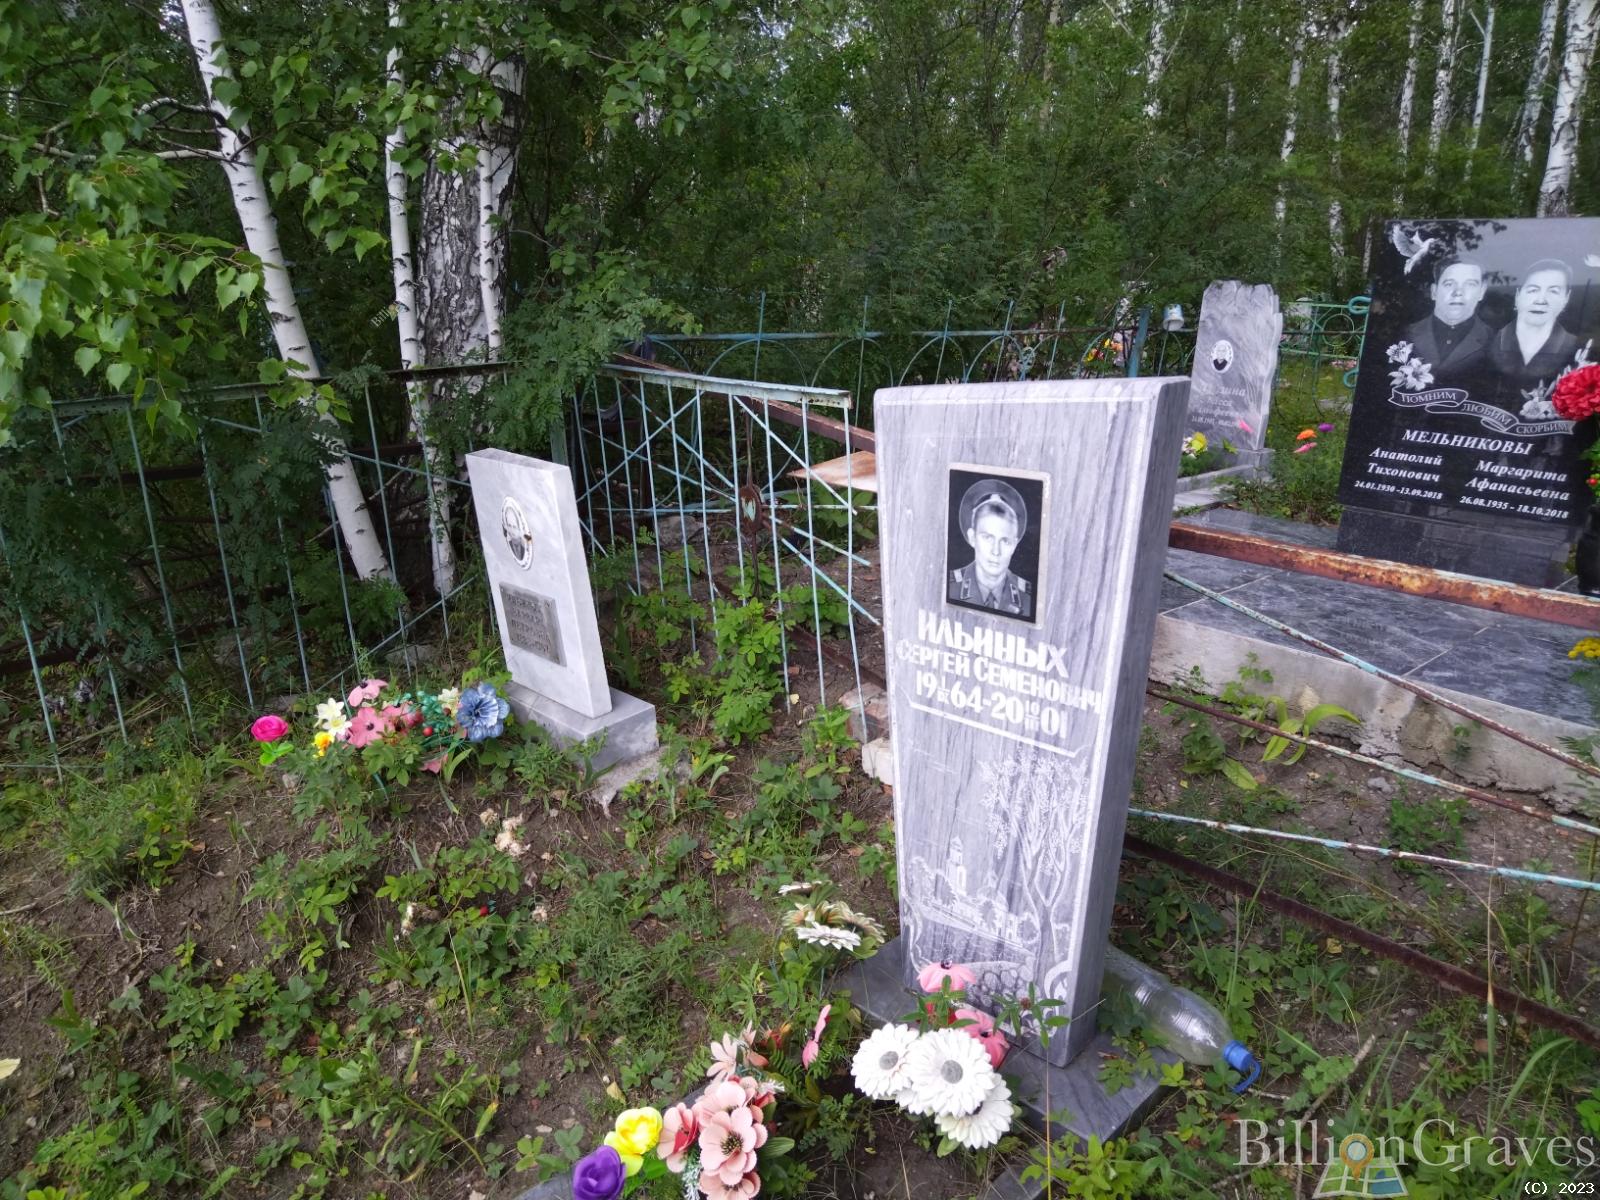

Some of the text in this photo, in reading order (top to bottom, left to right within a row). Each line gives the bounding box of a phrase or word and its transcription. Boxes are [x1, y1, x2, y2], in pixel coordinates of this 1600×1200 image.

[1401, 391, 1457, 404] ПОМНИМ
[1461, 403, 1513, 425] ЛЮБИМ
[1516, 422, 1568, 434] СКОРБИМ
[1402, 429, 1534, 456] МЕЛЬНИКОВЫ
[1369, 447, 1443, 466] Анатолий
[1367, 462, 1441, 482] Тихонович
[1476, 460, 1568, 482] Маргарита
[1465, 477, 1571, 502] Афанасьевна
[1459, 495, 1509, 510] 26.08.1935
[1516, 504, 1569, 519] 18.10.2018
[917, 608, 1069, 678] ИЛЬИНЫХ
[896, 639, 1103, 714] СЕРГЕЙ СЕМЕНОВИЧ
